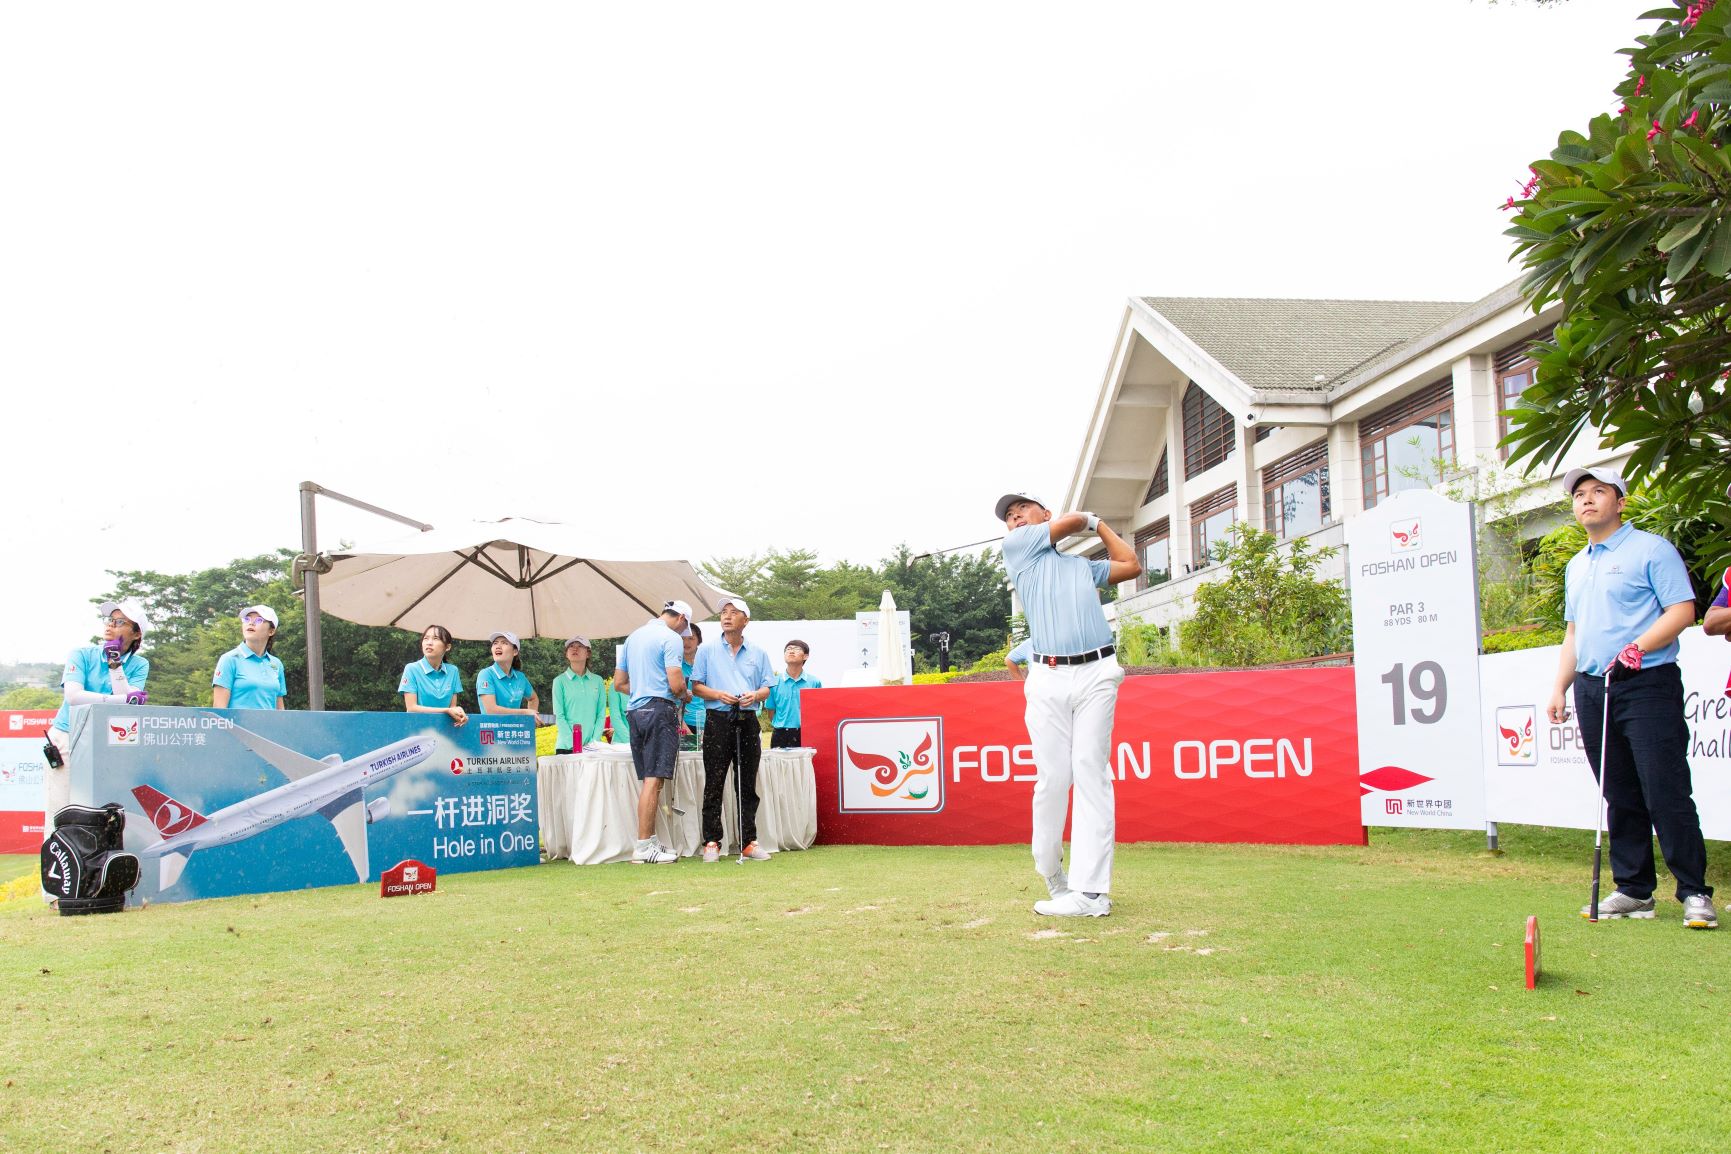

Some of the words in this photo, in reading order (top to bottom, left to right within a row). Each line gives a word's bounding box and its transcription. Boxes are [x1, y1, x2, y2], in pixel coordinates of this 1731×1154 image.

[1361, 557, 1415, 576] FOSHAN
[1420, 550, 1457, 568] OPEN
[1390, 602, 1413, 616] PAR
[1417, 601, 1425, 613] 3
[1395, 616, 1411, 626] YDS
[1417, 615, 1428, 624] 80
[1429, 613, 1438, 622] M
[1381, 661, 1448, 725] 19
[1684, 691, 1731, 723] Gre
[142, 717, 197, 729] FOSHAN
[200, 717, 234, 729] OPEN
[143, 732, 207, 746] 佛山公开赛
[1550, 727, 1585, 750] OPE
[370, 754, 397, 772] TURKISH
[397, 745, 421, 762] AIRLINES
[466, 757, 498, 765] TURKISH
[499, 756, 530, 765] AIRLINES
[953, 742, 1151, 782] FOSN
[1173, 737, 1313, 780] OPEN
[407, 792, 533, 829] 一杆进洞奖
[1406, 799, 1453, 809] 新世界中国
[433, 835, 476, 859] Hole
[480, 833, 495, 855] in
[500, 831, 535, 852] One
[49, 841, 71, 895] Callaway
[387, 884, 414, 893] FOSHAN
[415, 882, 432, 891] OPEN
